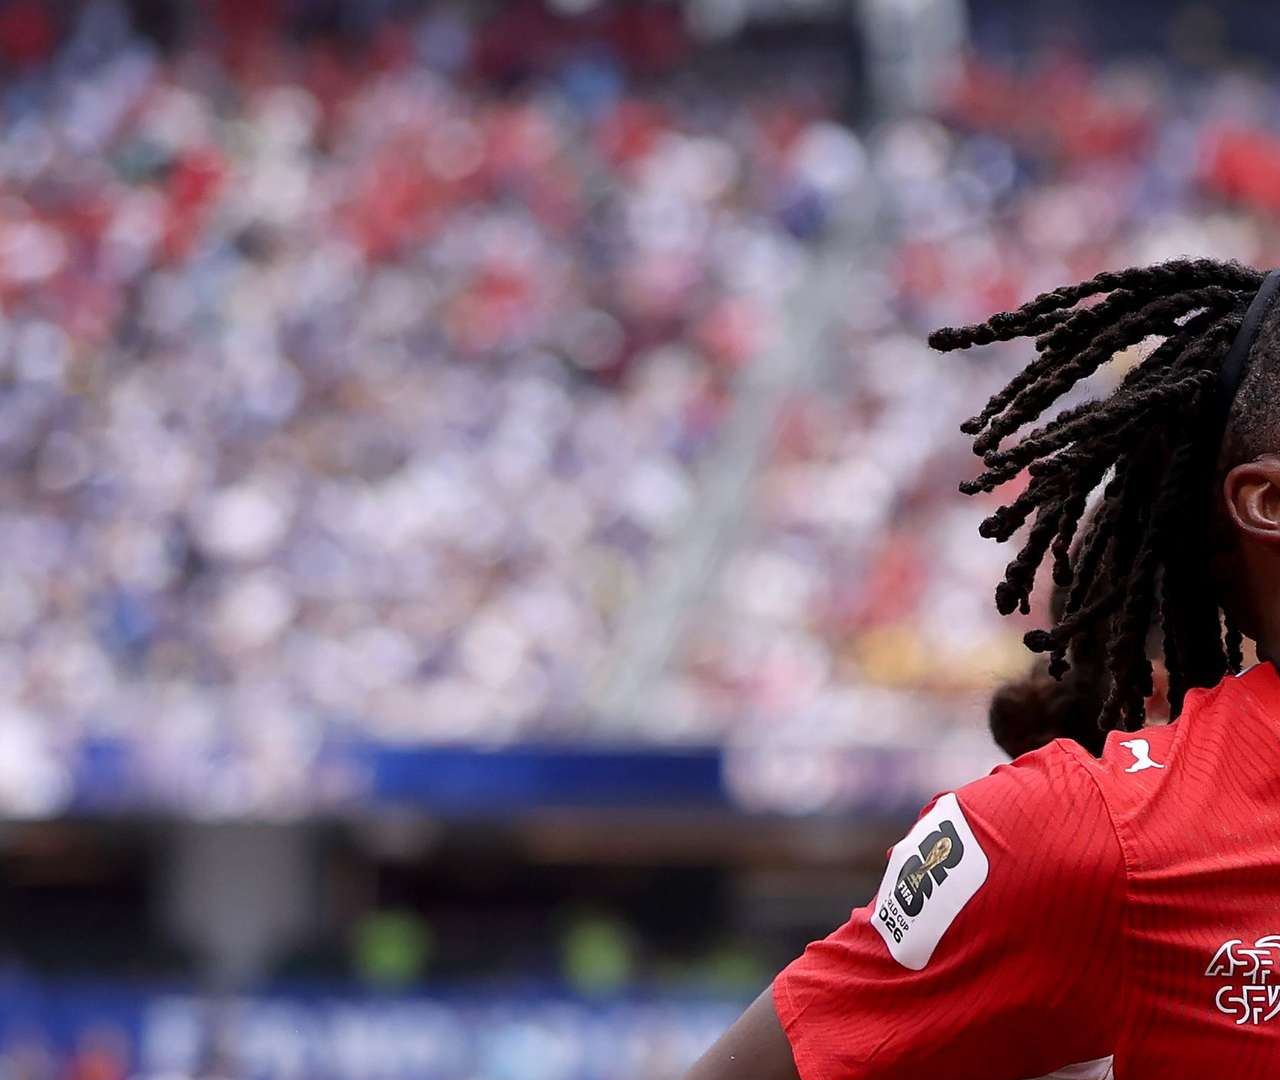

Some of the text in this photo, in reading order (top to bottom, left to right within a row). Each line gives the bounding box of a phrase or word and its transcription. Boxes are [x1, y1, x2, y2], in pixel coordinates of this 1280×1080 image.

[898, 880, 914, 906] FIFA
[879, 904, 904, 944] 026
[896, 914, 910, 931] CUP
[1205, 939, 1273, 985] ASF
